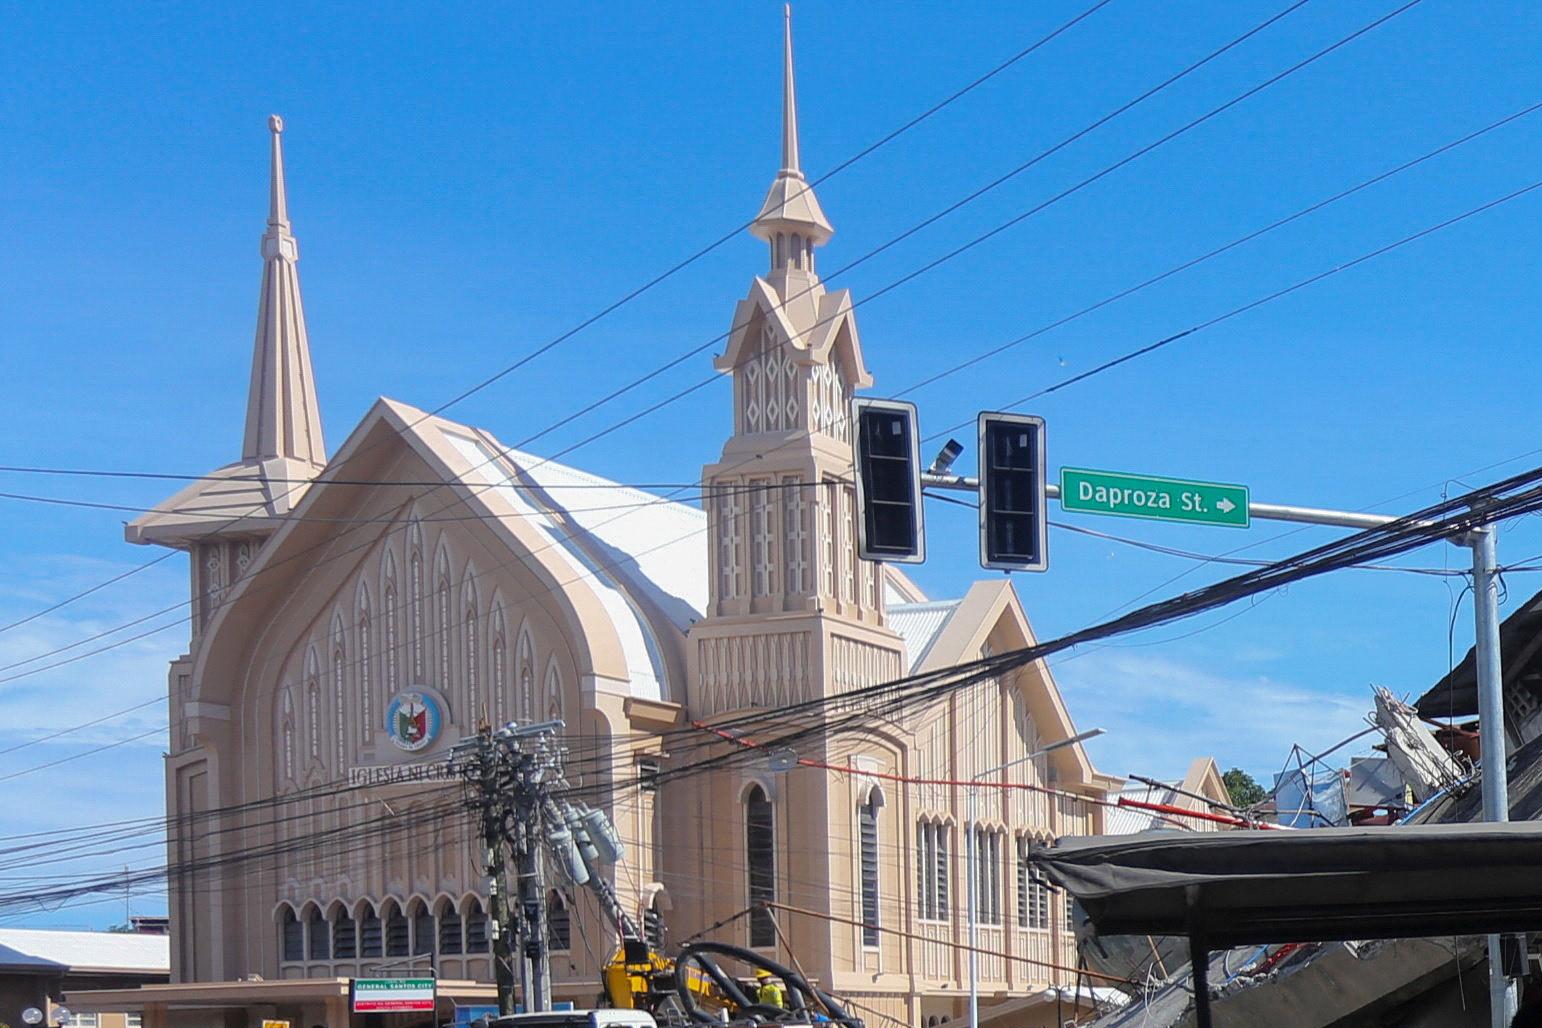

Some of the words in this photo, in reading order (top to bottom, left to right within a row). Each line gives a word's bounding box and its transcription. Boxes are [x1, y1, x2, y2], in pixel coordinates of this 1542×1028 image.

[1079, 481, 1170, 509] Daproza
[1181, 492, 1208, 512] St.
[352, 766, 403, 784] IGLESIA
